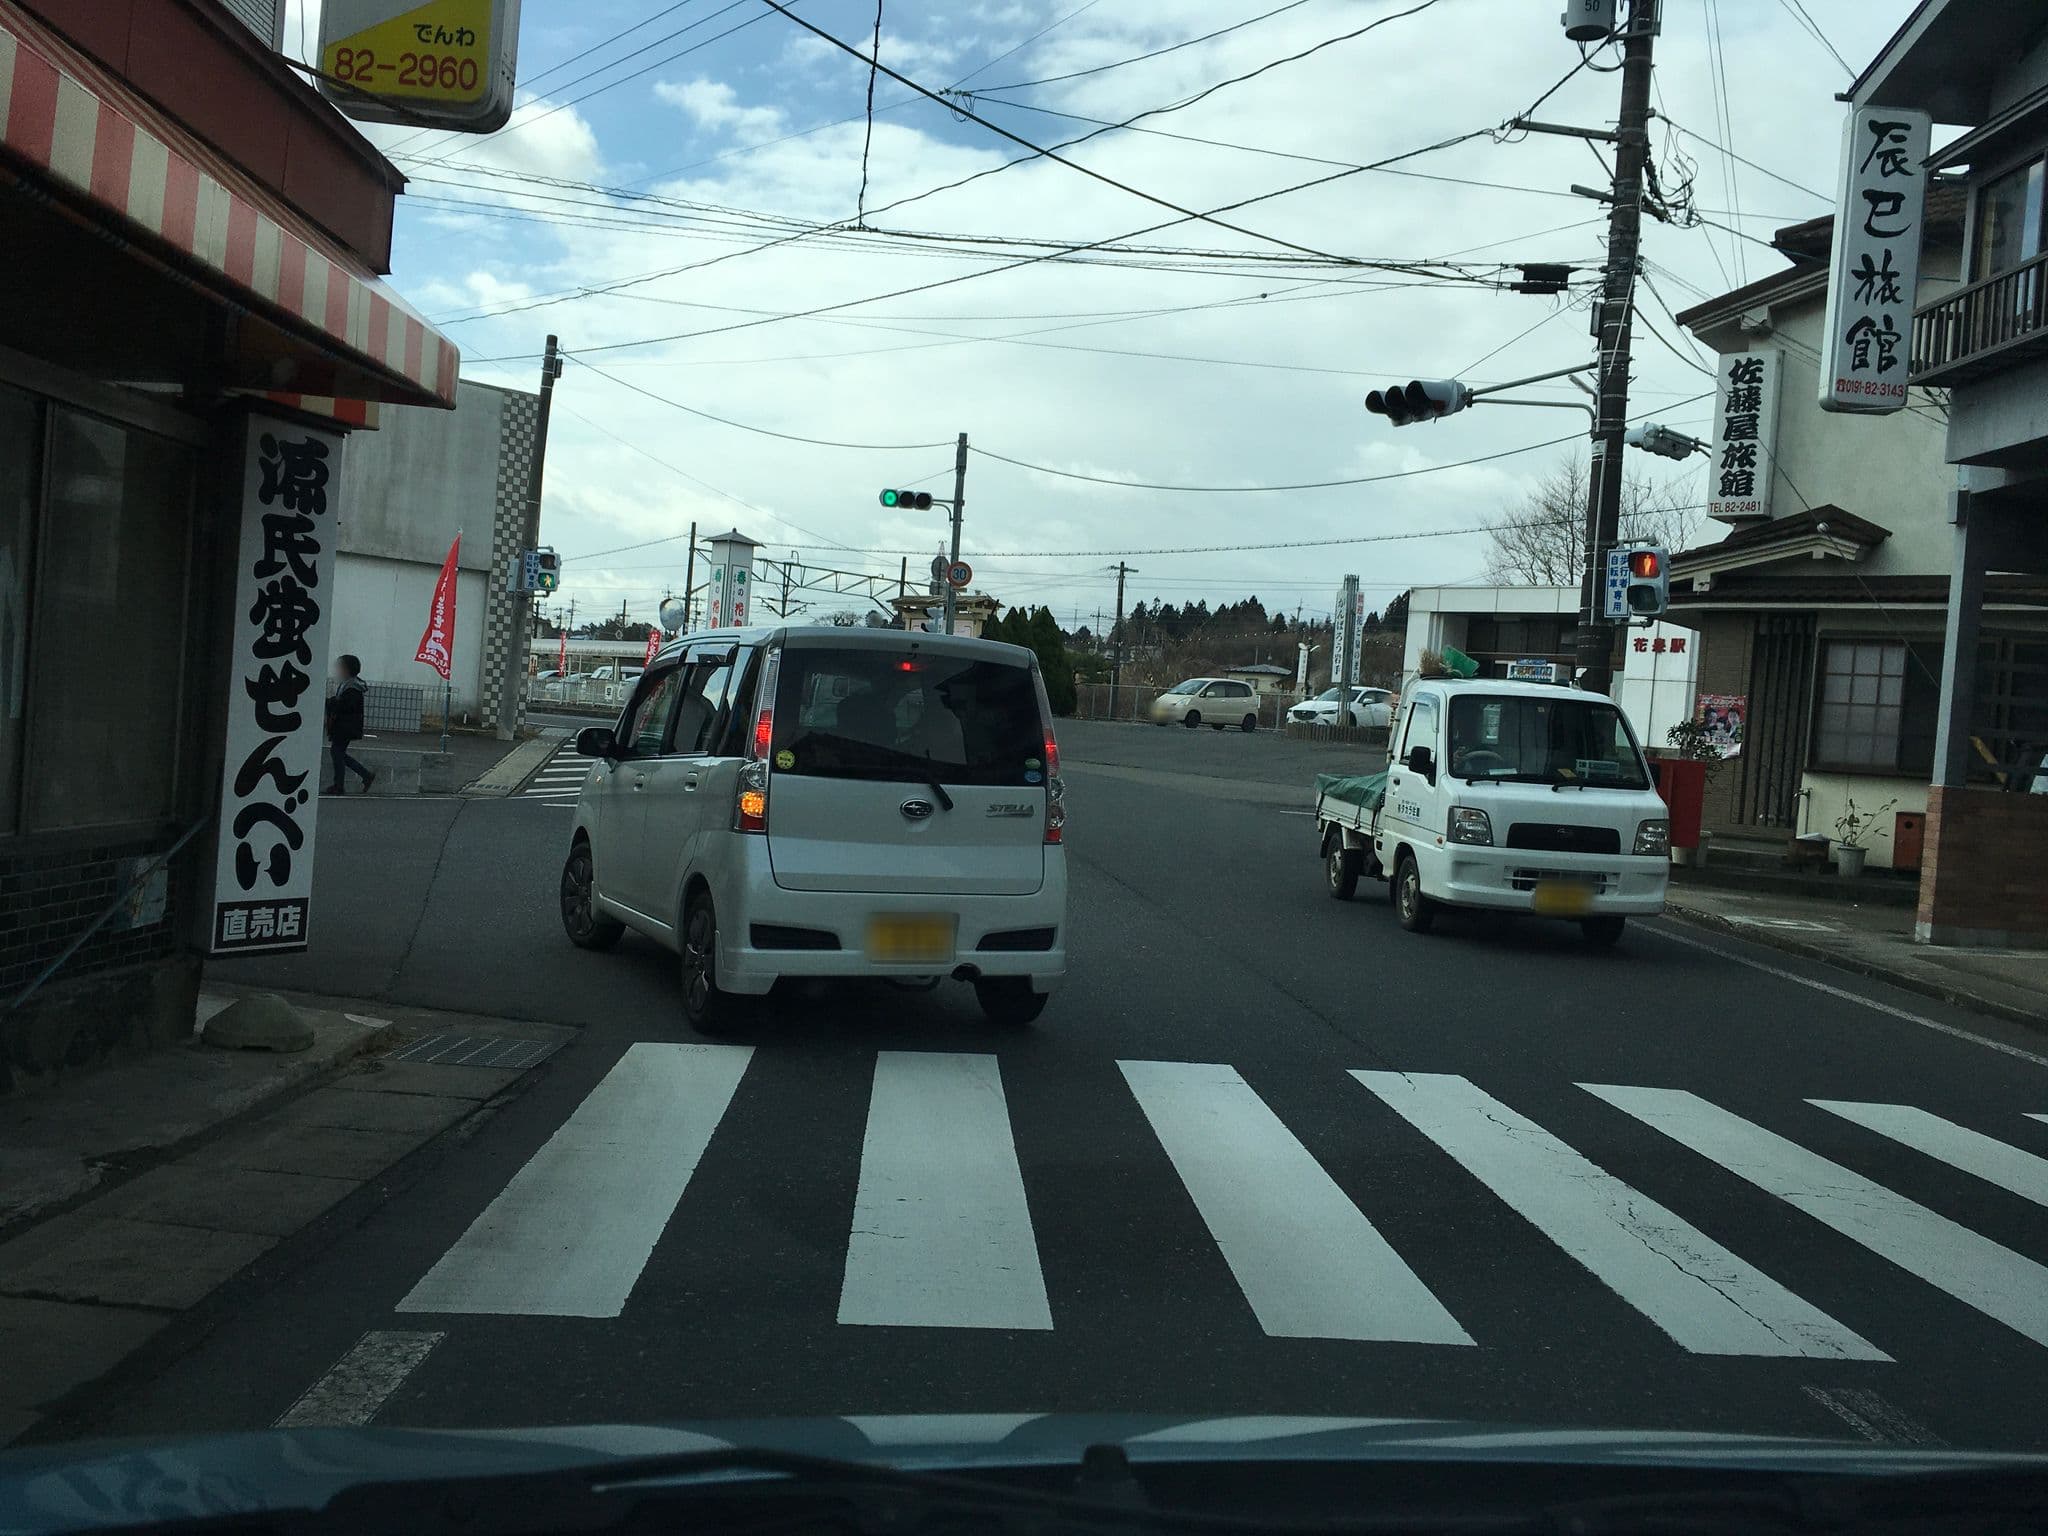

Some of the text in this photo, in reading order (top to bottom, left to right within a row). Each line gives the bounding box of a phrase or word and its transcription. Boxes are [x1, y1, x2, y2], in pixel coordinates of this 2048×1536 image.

[413, 23, 475, 46] でんわ
[334, 47, 478, 91] 82-2960
[1845, 118, 1915, 375] 辰巳旅館
[1718, 357, 1765, 497] 佐藤屋旅館
[1709, 500, 1761, 513] TEL 82-2481
[953, 568, 967, 580] 30
[222, 904, 302, 942] 直売店
